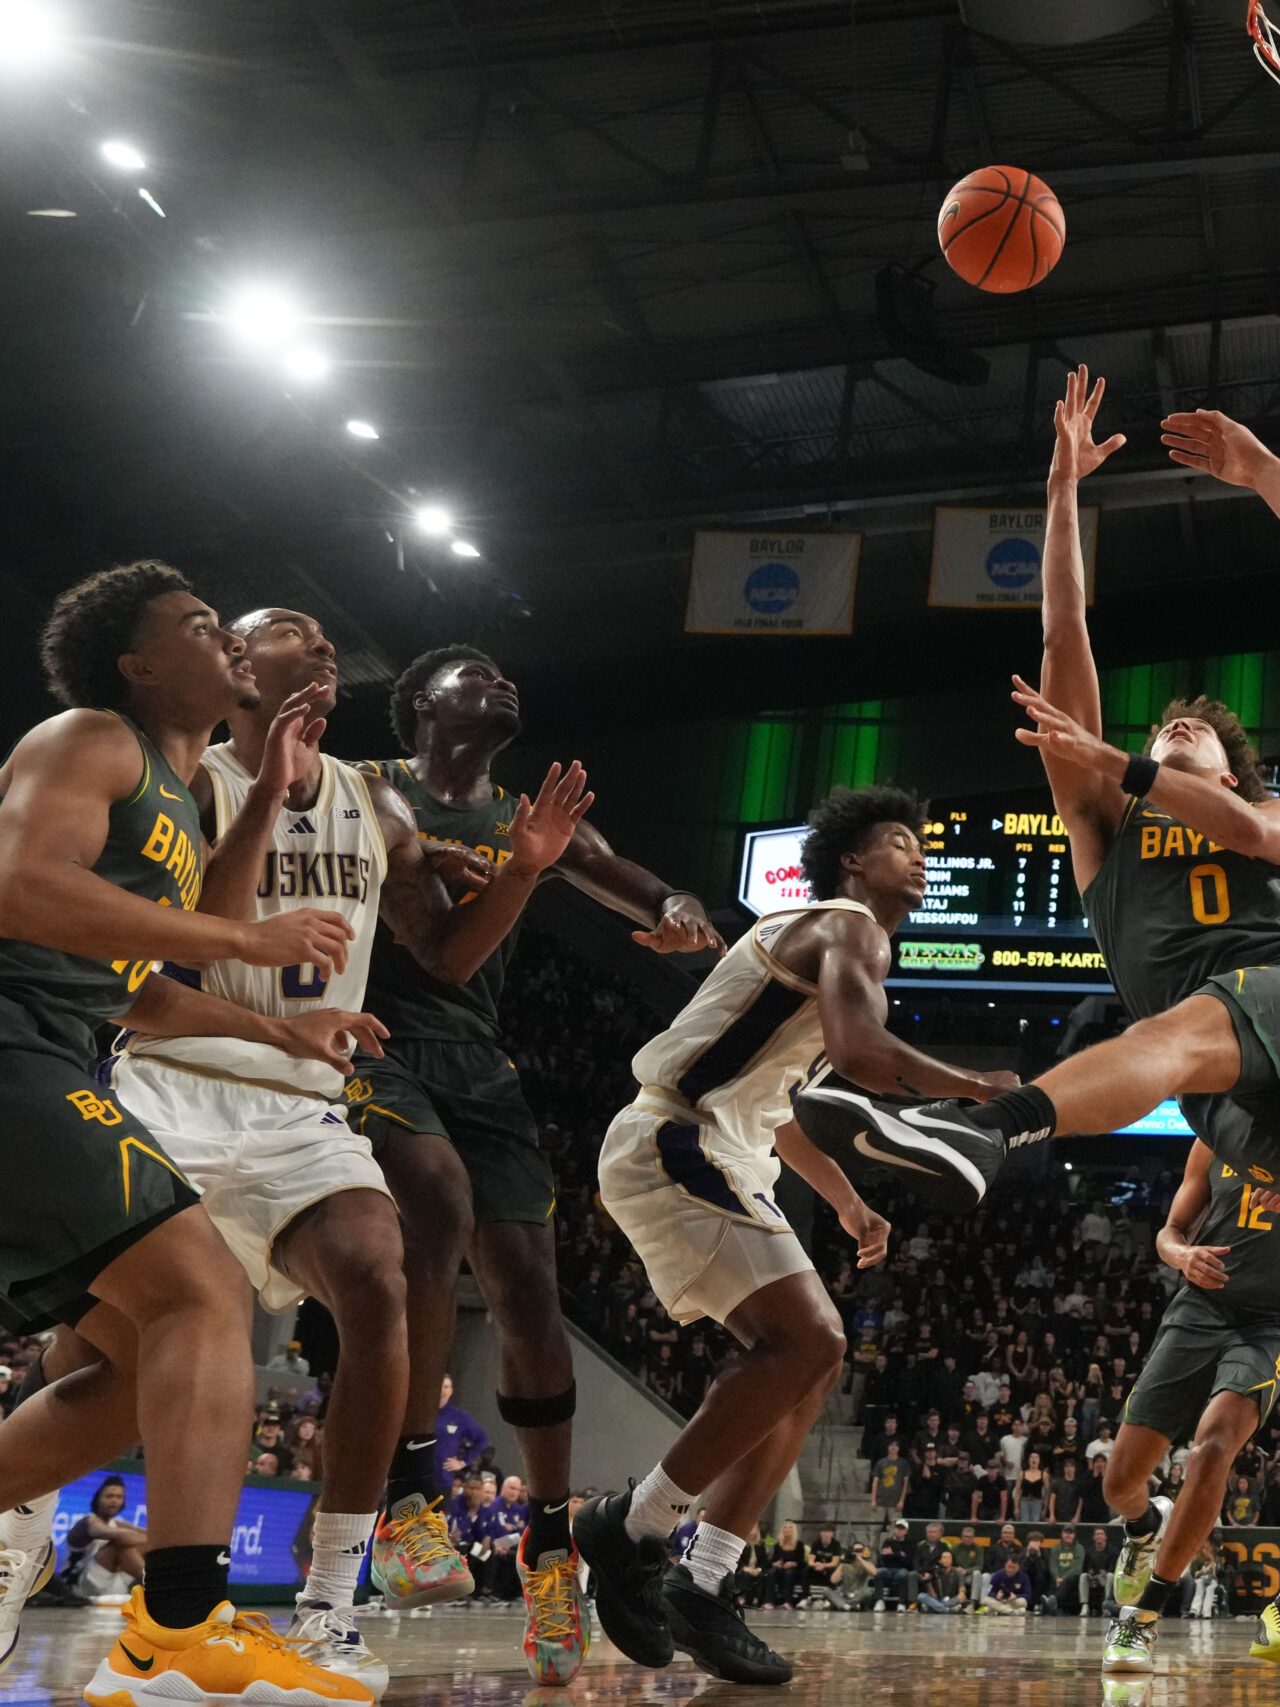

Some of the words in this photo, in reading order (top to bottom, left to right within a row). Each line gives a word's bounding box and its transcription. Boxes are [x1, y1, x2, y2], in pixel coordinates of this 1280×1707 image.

[988, 514, 1043, 529] BAYLOR
[750, 538, 805, 554] BAYLOR
[954, 824, 961, 835] 1
[1016, 843, 1032, 852] PTS
[1141, 826, 1225, 859] BAY
[141, 811, 202, 912] BAYLO
[926, 856, 976, 869] KILLINGS
[976, 857, 996, 870] JR.
[1018, 857, 1027, 869] 7
[1052, 859, 1060, 870] 2
[256, 852, 370, 905] USKIES
[924, 884, 970, 897] ILLIAMS
[1050, 888, 1058, 899] 2
[1189, 864, 1231, 925] 0
[1013, 901, 1025, 912] 11
[1049, 902, 1057, 913] 3
[909, 912, 978, 925] YESSOUFOU
[1014, 915, 1023, 927] 7
[1048, 917, 1056, 928] 2
[1082, 917, 1089, 928] 1
